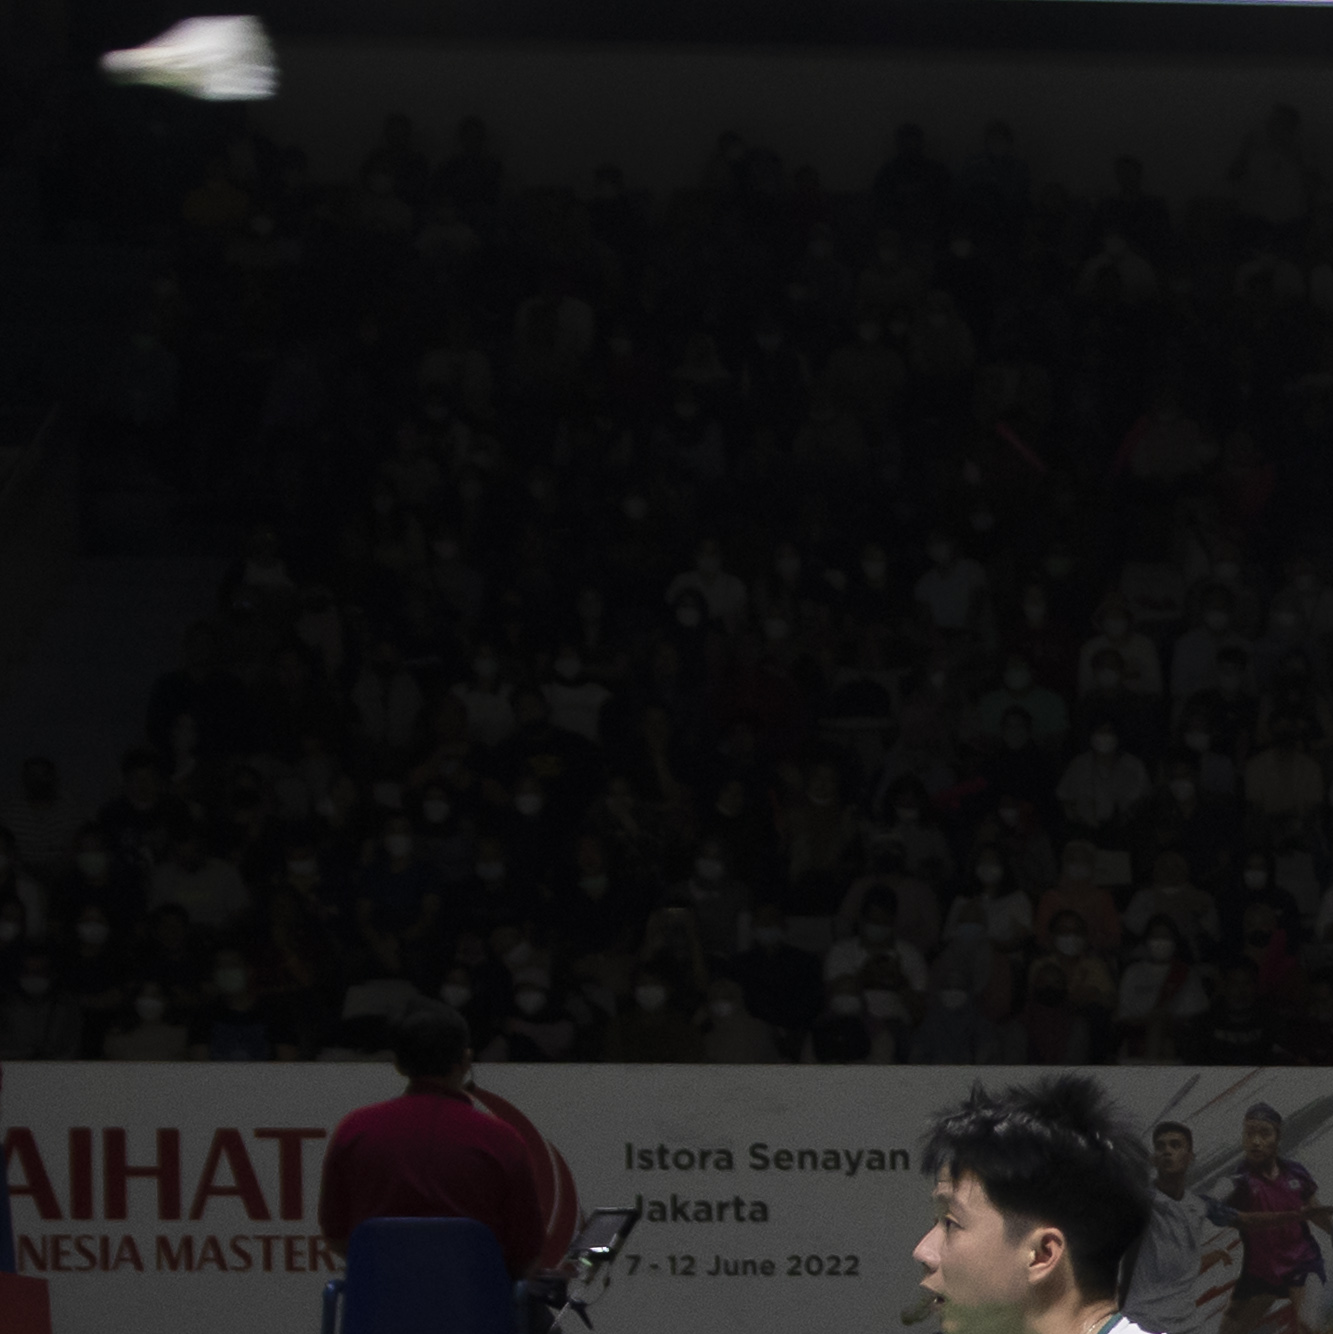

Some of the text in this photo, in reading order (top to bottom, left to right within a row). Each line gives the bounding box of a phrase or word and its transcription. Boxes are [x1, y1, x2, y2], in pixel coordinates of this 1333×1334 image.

[624, 1143, 910, 1176] Istora Senayan
[634, 1194, 769, 1223] Jakarta
[18, 1234, 145, 1272] NESIA
[626, 1255, 642, 1276] 7
[669, 1255, 696, 1276] 12
[707, 1255, 776, 1276] June
[786, 1255, 860, 1276] 2022
